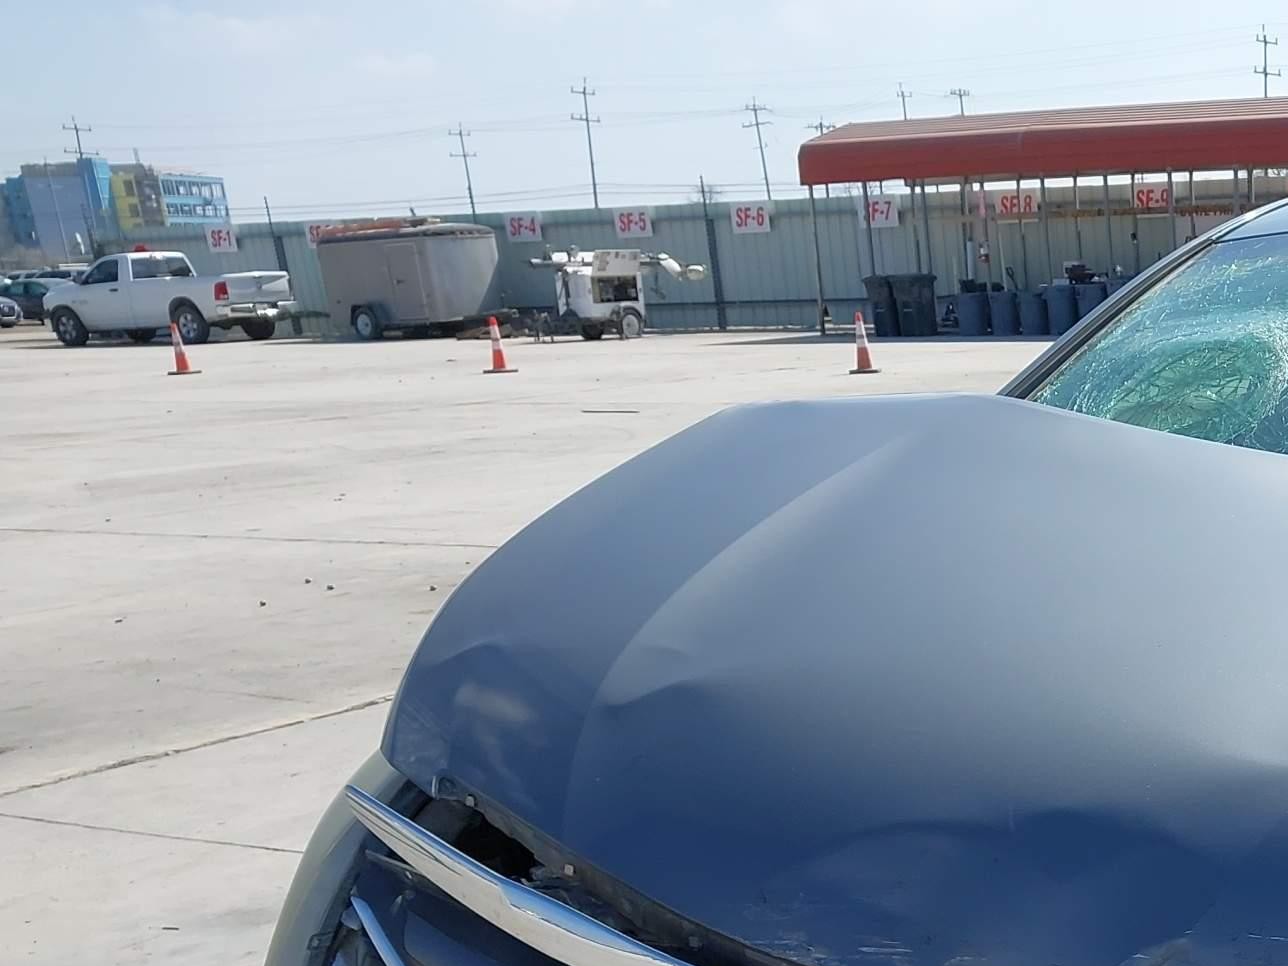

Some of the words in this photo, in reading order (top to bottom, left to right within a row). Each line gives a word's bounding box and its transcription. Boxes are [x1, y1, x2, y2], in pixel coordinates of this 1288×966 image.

[1000, 194, 1033, 215] SF8
[509, 216, 537, 237] SF-4
[618, 212, 647, 233] SF-5
[735, 206, 765, 228] SF-6
[209, 229, 232, 248] SF-1
